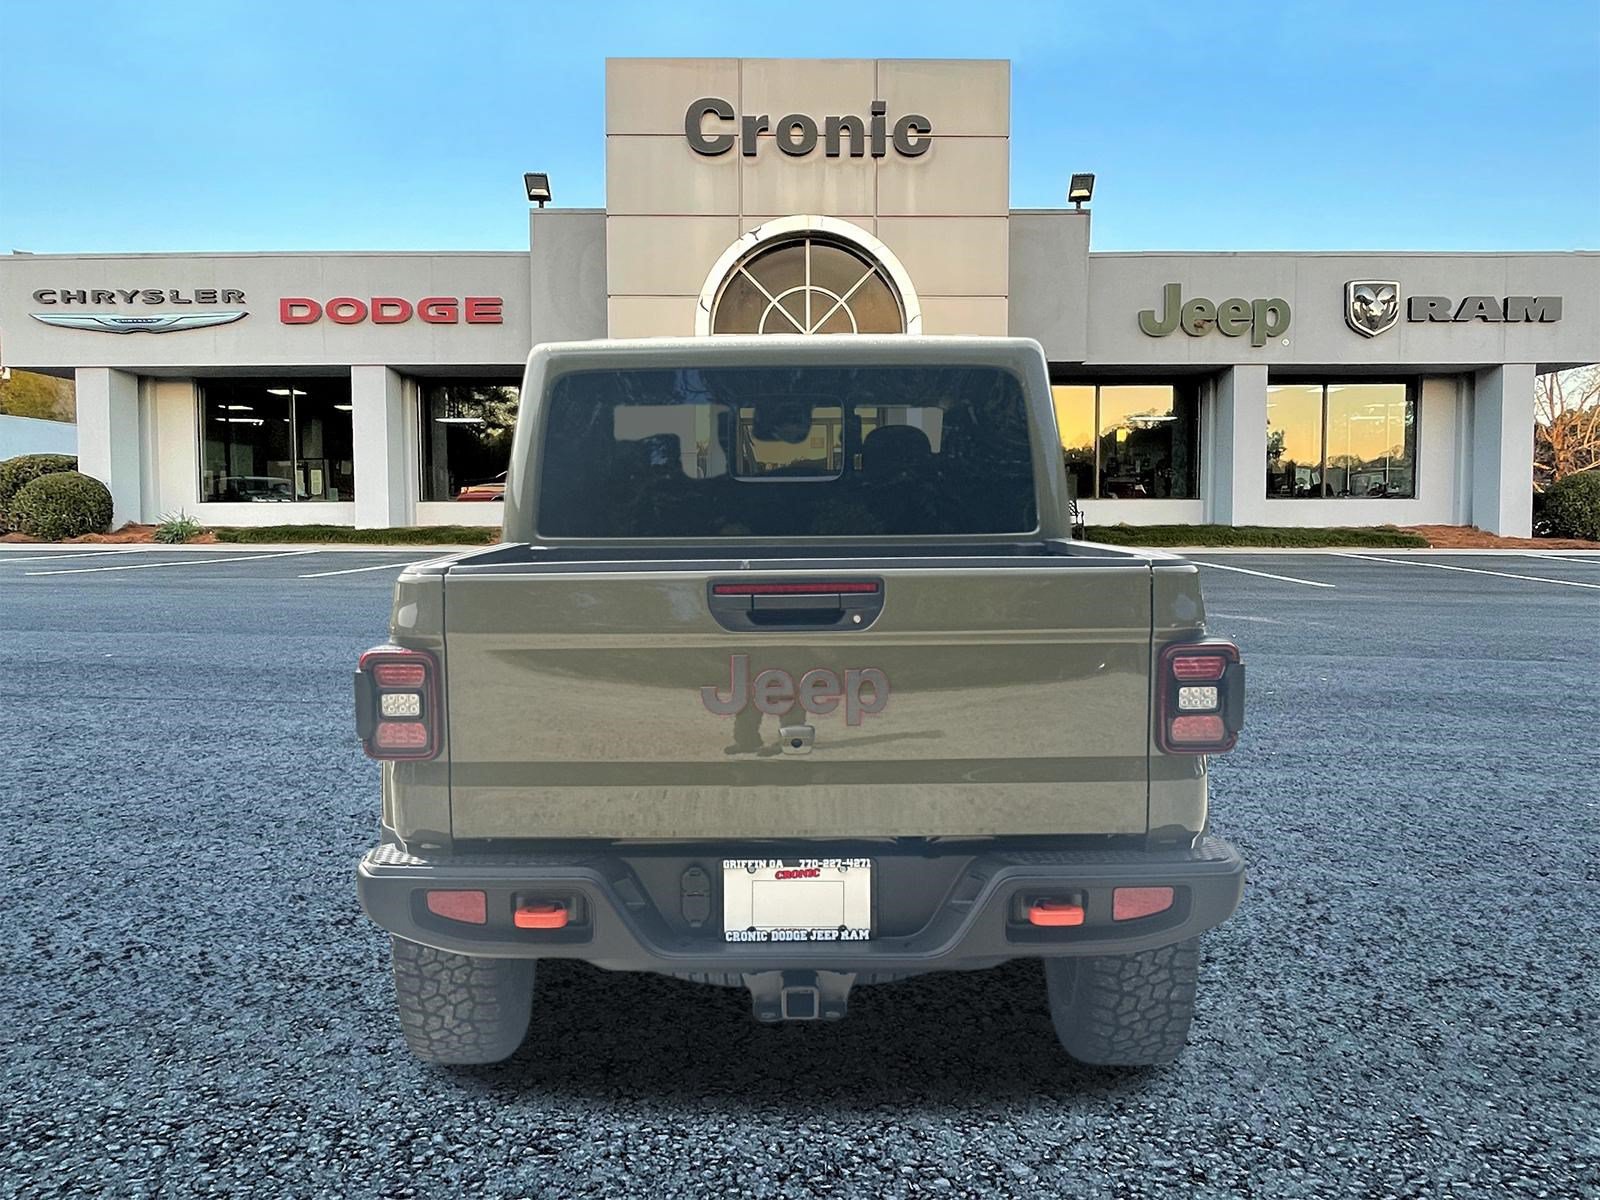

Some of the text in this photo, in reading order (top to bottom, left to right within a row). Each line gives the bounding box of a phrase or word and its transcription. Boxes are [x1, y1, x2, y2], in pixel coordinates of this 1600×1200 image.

[685, 97, 932, 157] Cronic
[32, 288, 247, 305] CHRYSLER
[1407, 296, 1563, 323] RAM
[279, 296, 504, 325] DODGE
[1138, 283, 1292, 347] Jeep
[700, 654, 891, 726] Jeep
[723, 859, 767, 869] GRIFFIN
[799, 858, 871, 868] 770-227-4271
[775, 868, 821, 880] CRONIC
[725, 930, 768, 942] CRONIC
[771, 930, 807, 941] DODGE
[810, 929, 839, 941] JEEP
[840, 929, 870, 940] RAM
